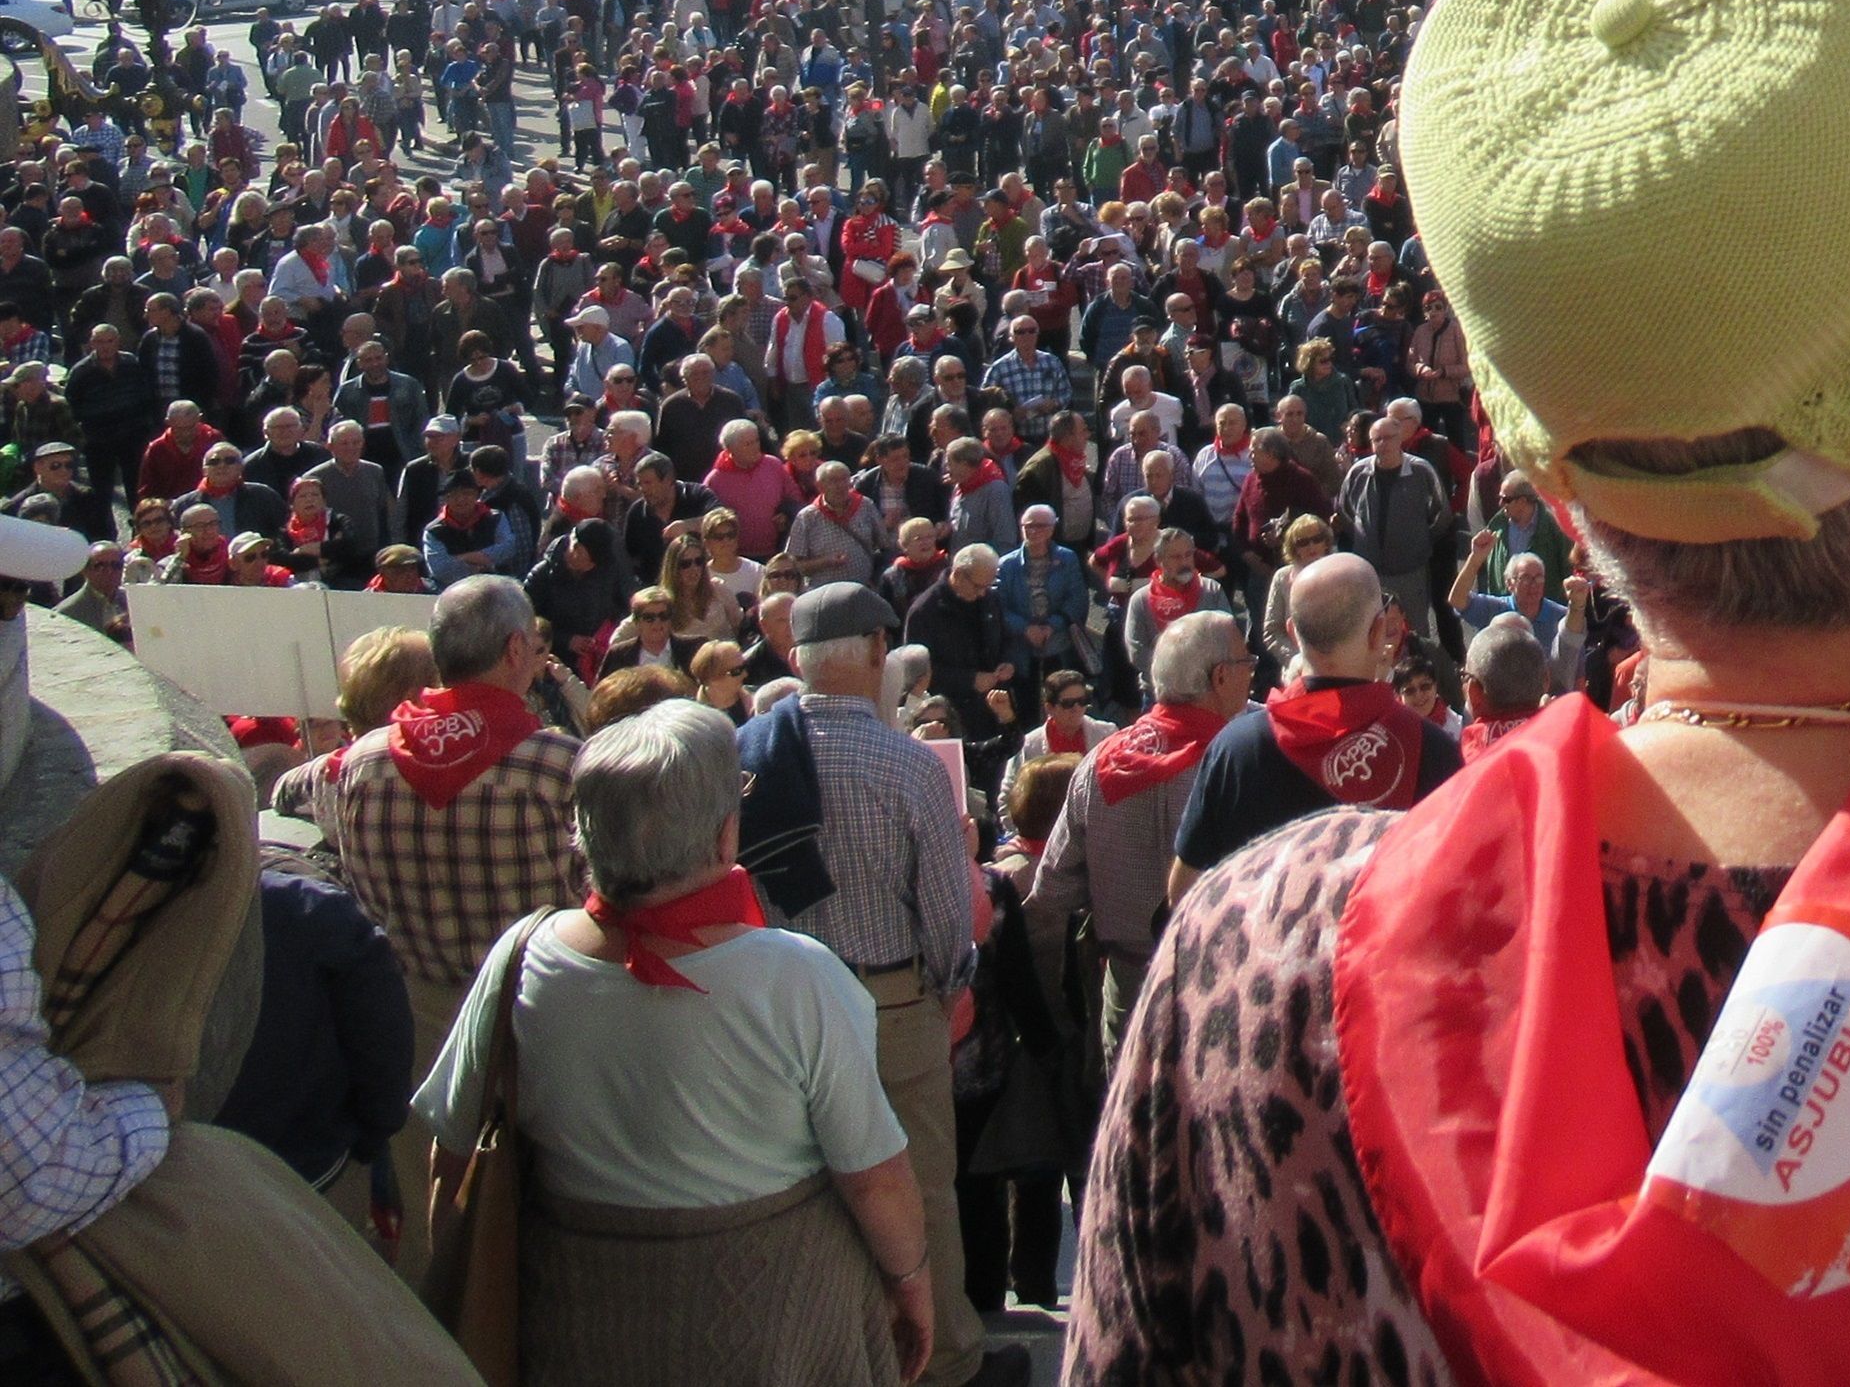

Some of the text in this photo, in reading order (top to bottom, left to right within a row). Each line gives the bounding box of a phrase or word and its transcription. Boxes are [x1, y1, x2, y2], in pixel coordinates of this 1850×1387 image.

[1339, 737, 1372, 769] MPB
[1747, 1017, 1786, 1066] 100%
[1756, 986, 1848, 1153] sin penalizar
